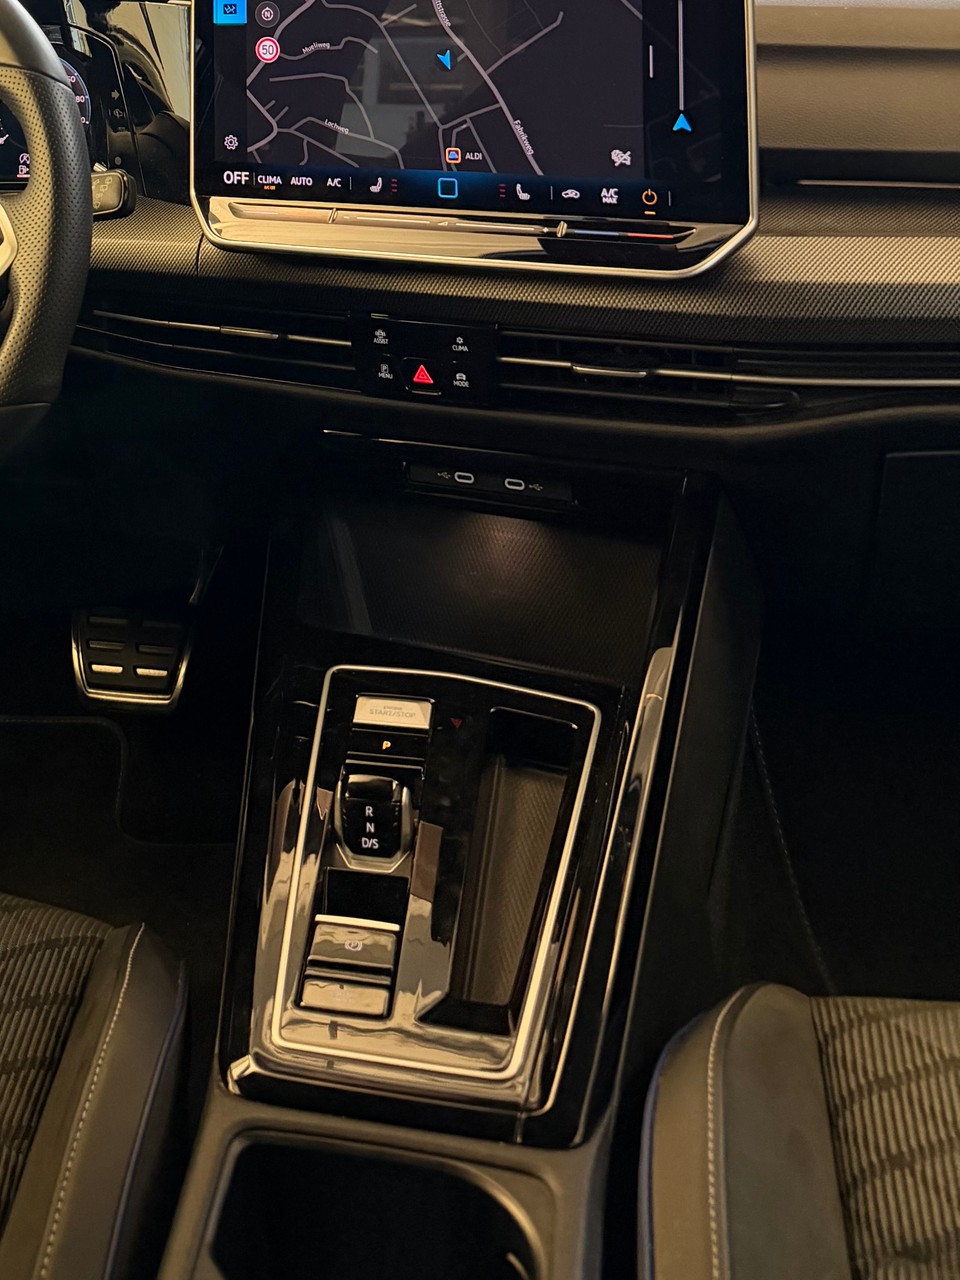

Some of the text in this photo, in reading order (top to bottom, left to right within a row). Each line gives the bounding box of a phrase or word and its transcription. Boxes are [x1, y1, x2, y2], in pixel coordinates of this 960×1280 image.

[261, 45, 275, 56] 50
[324, 119, 349, 135] Lochweg
[513, 119, 535, 156] Fabrikweg
[465, 152, 482, 161] ALDI
[223, 170, 249, 185] OFF
[257, 175, 282, 185] CLIMA
[290, 176, 313, 186] AUTO
[326, 177, 342, 187] A/C
[600, 187, 619, 198] A/C
[602, 196, 618, 205] MAX
[452, 344, 469, 352] CLIMA
[453, 380, 470, 388] MODE
[382, 740, 392, 750] P
[365, 806, 374, 817] R
[366, 822, 375, 834] N
[361, 837, 379, 849] D/S
